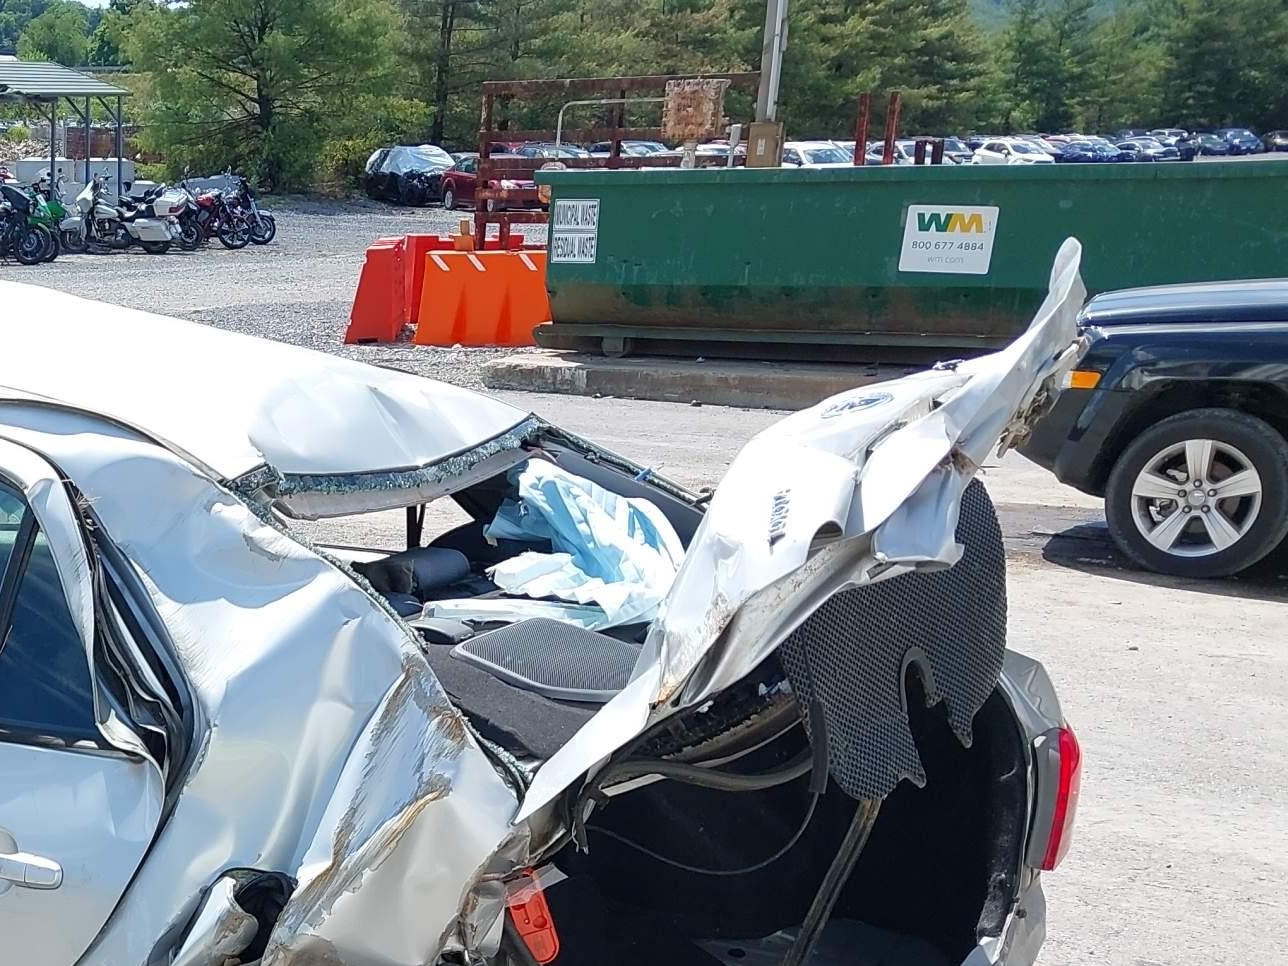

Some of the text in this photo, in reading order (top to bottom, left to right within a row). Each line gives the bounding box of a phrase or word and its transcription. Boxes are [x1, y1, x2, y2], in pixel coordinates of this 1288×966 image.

[556, 204, 597, 226] MUNICIPAL WASTE
[917, 212, 984, 233] WM
[553, 236, 595, 258] RESIDUAL WASTE
[911, 240, 984, 251] 800 677 4884
